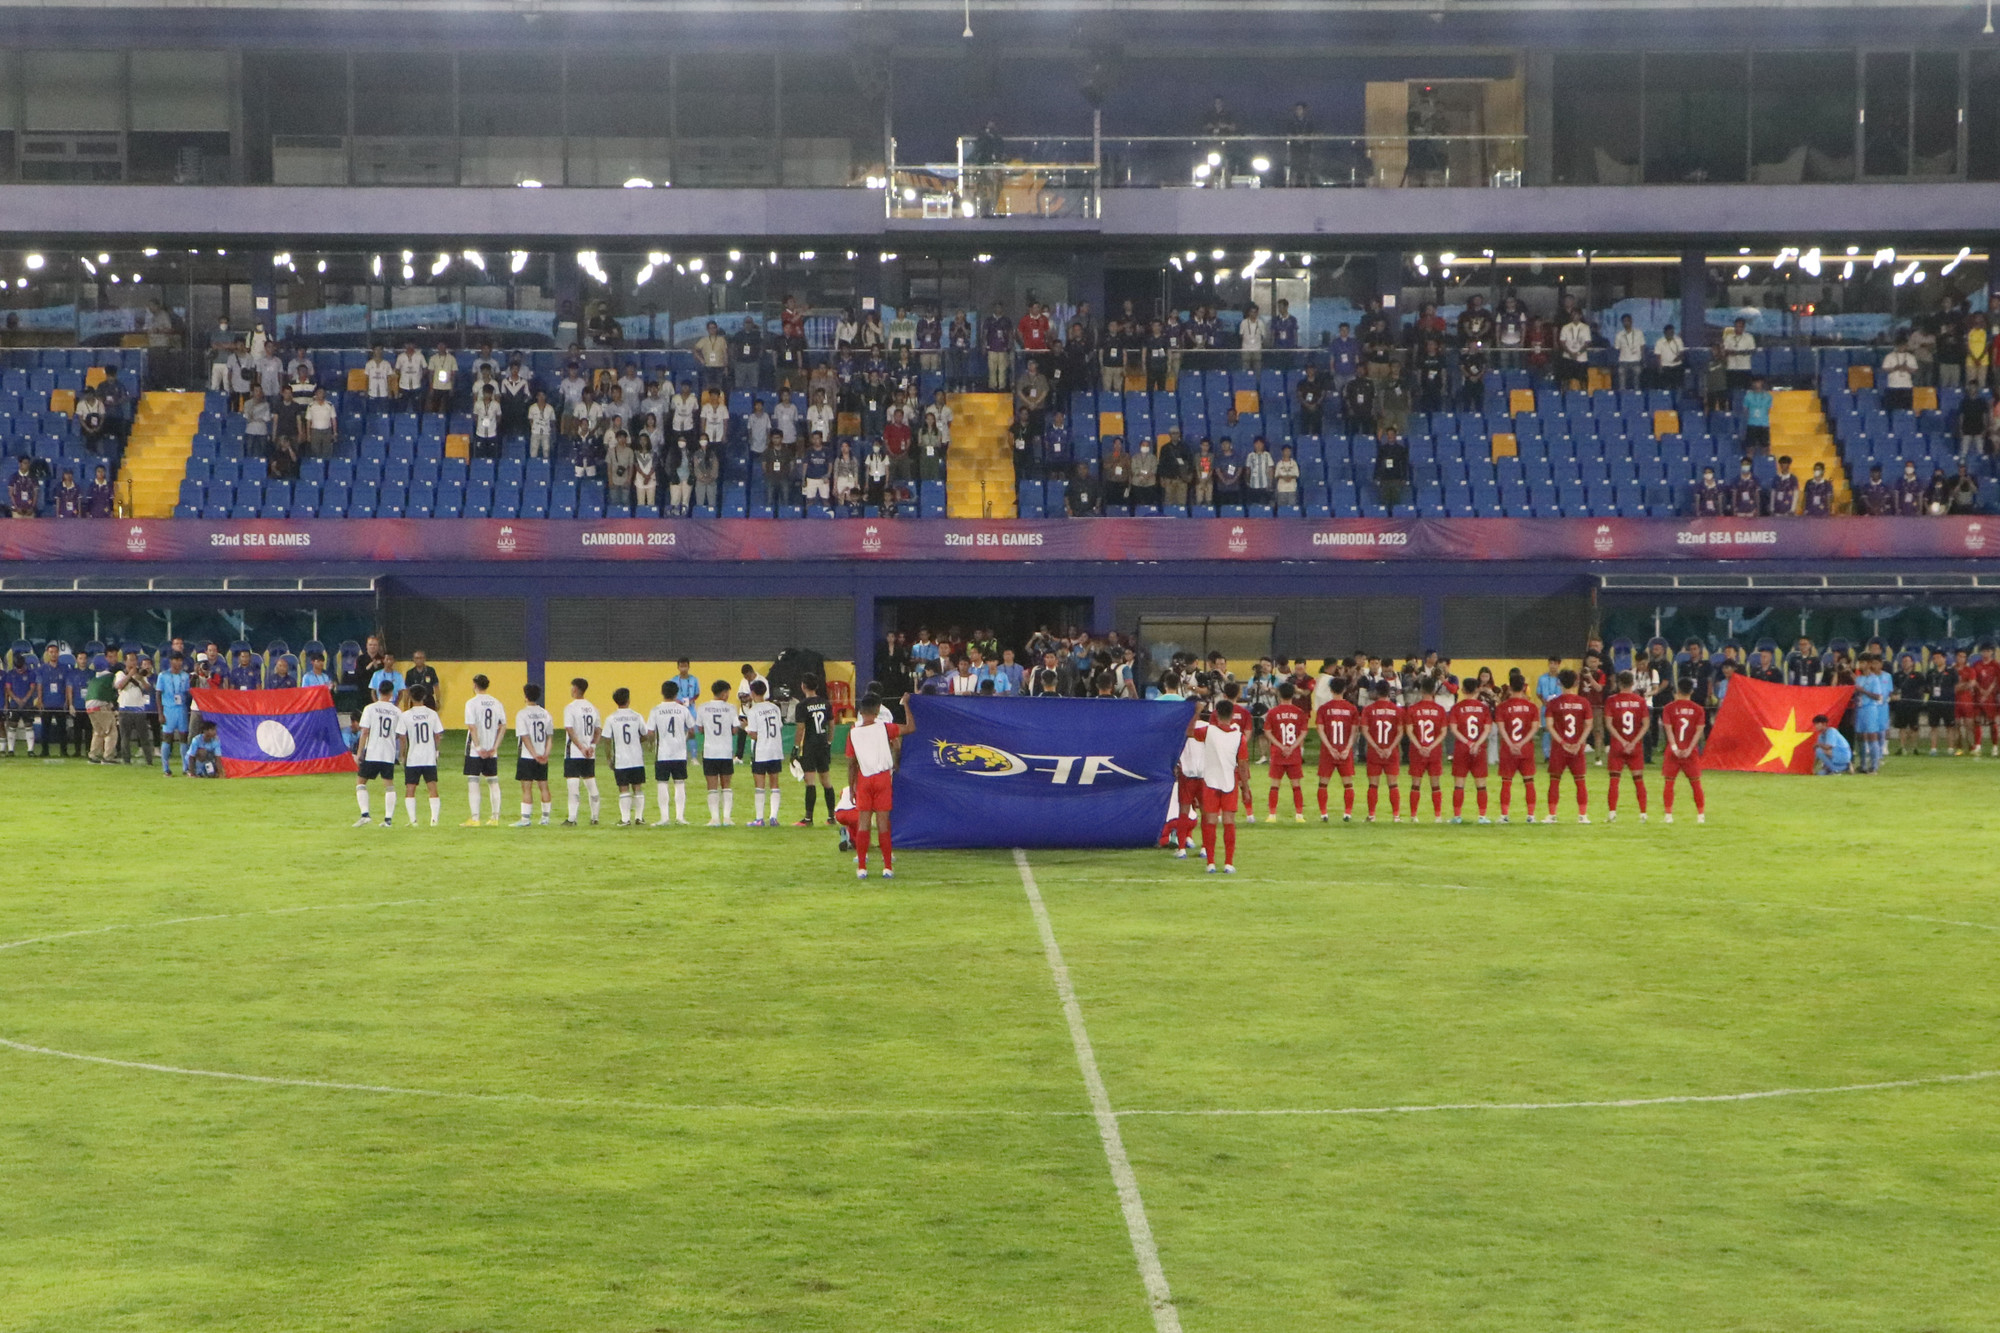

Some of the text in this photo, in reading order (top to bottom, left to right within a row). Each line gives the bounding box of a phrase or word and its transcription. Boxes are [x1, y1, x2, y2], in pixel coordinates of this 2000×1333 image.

[210, 533, 311, 546] 32nd SEA GAMES
[581, 532, 676, 546] CAMBODIA 2023
[944, 533, 1043, 546] 32nd SEA GAMES
[1312, 532, 1407, 545] CAMBODIA 2023
[1676, 531, 1777, 544] 32nd SEA GAMES
[378, 715, 392, 739] 19
[484, 707, 493, 730] 8
[582, 714, 594, 737] 18
[667, 716, 676, 738] 4
[712, 713, 723, 737] 5
[764, 715, 778, 739] 15
[811, 710, 826, 735] 12
[1466, 714, 1479, 740] 6
[1511, 717, 1524, 742] 2
[1564, 713, 1576, 738] 3
[1622, 710, 1635, 736] 9
[1679, 717, 1690, 742] 7
[414, 721, 430, 745] 10
[532, 720, 546, 744] 13
[622, 723, 632, 745] 6
[1279, 722, 1297, 746] 18
[1330, 720, 1344, 745] 11
[1376, 720, 1393, 745] 17
[1417, 719, 1435, 744] 12
